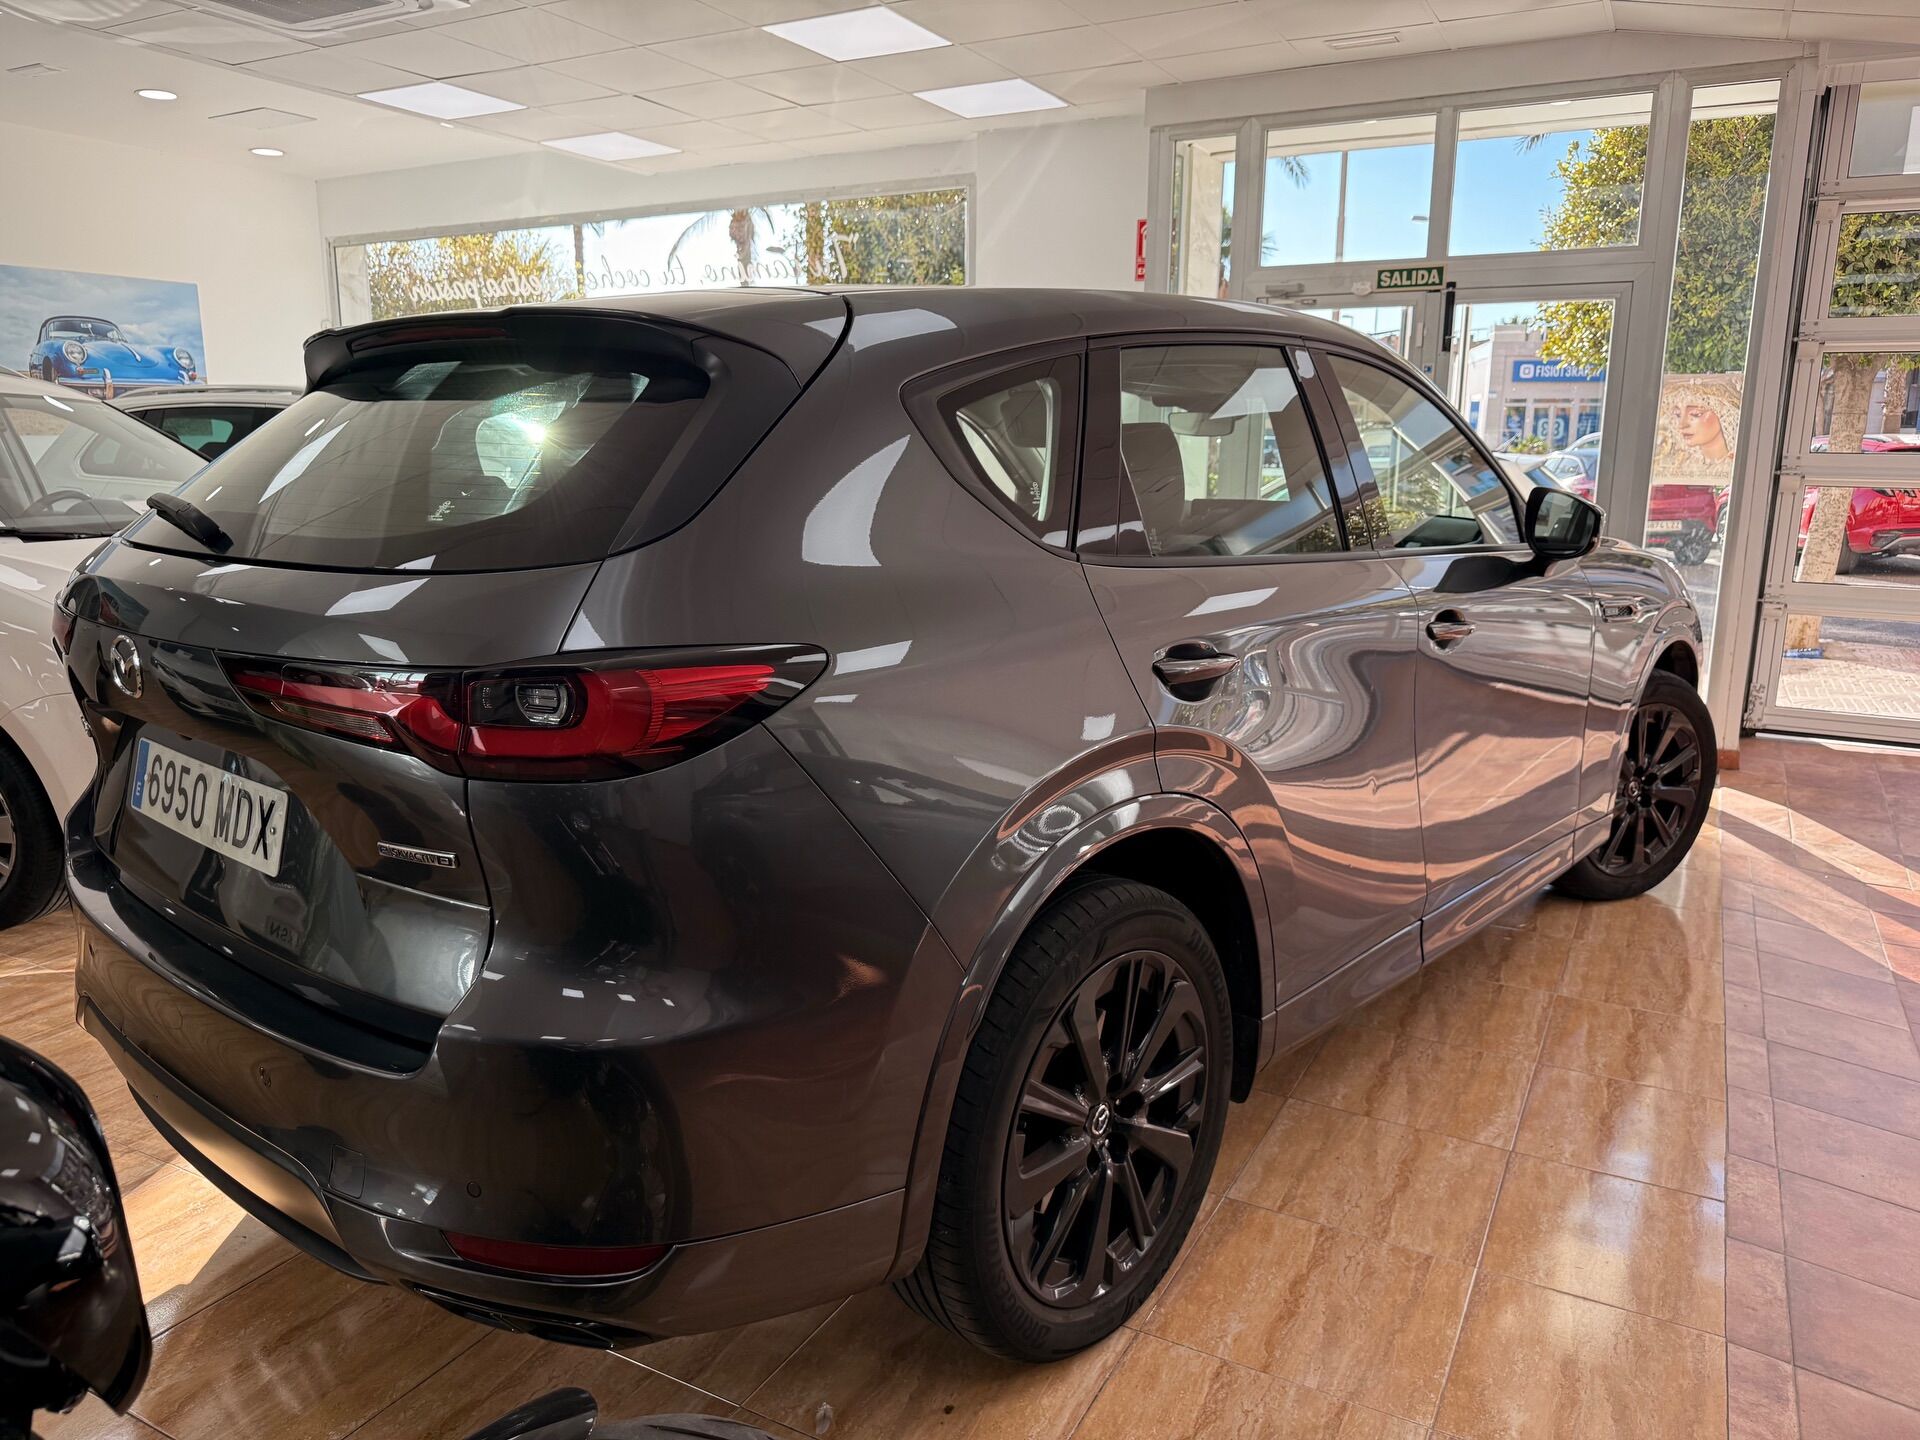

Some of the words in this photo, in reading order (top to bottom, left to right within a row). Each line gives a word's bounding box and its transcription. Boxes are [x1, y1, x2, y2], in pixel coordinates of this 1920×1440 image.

[1380, 268, 1440, 287] SALIDA
[135, 782, 142, 796] E
[147, 753, 208, 829] 6950
[213, 780, 276, 860] MDX
